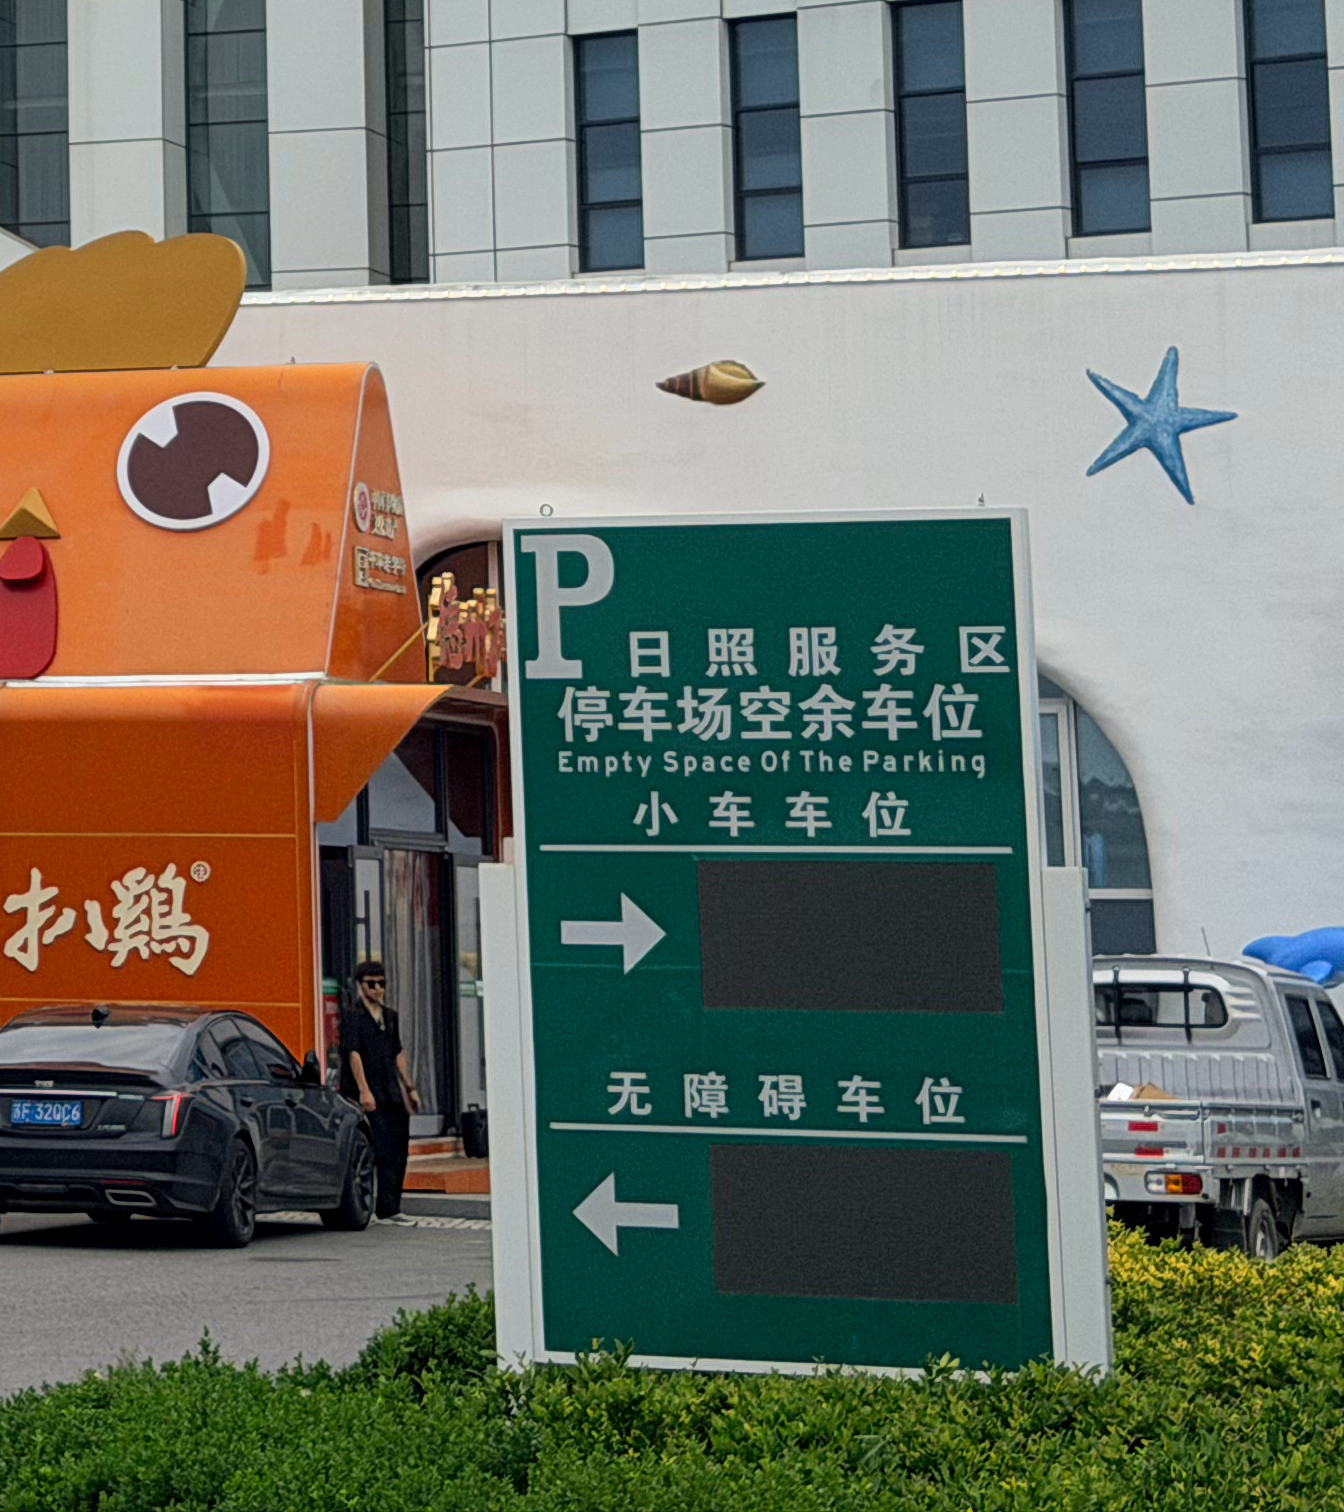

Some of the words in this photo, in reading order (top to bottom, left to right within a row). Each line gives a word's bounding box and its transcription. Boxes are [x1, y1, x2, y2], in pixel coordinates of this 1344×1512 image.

[521, 534, 615, 680] P
[628, 624, 1011, 678] 日照服务区
[557, 683, 983, 743] 停车场空余车位
[558, 750, 653, 777] Empty
[663, 750, 752, 776] Space
[760, 750, 791, 773] Of
[799, 750, 853, 773] The
[862, 750, 986, 779] Parking
[632, 790, 913, 838] 小车车位
[606, 1070, 967, 1125] 无障碍车位
